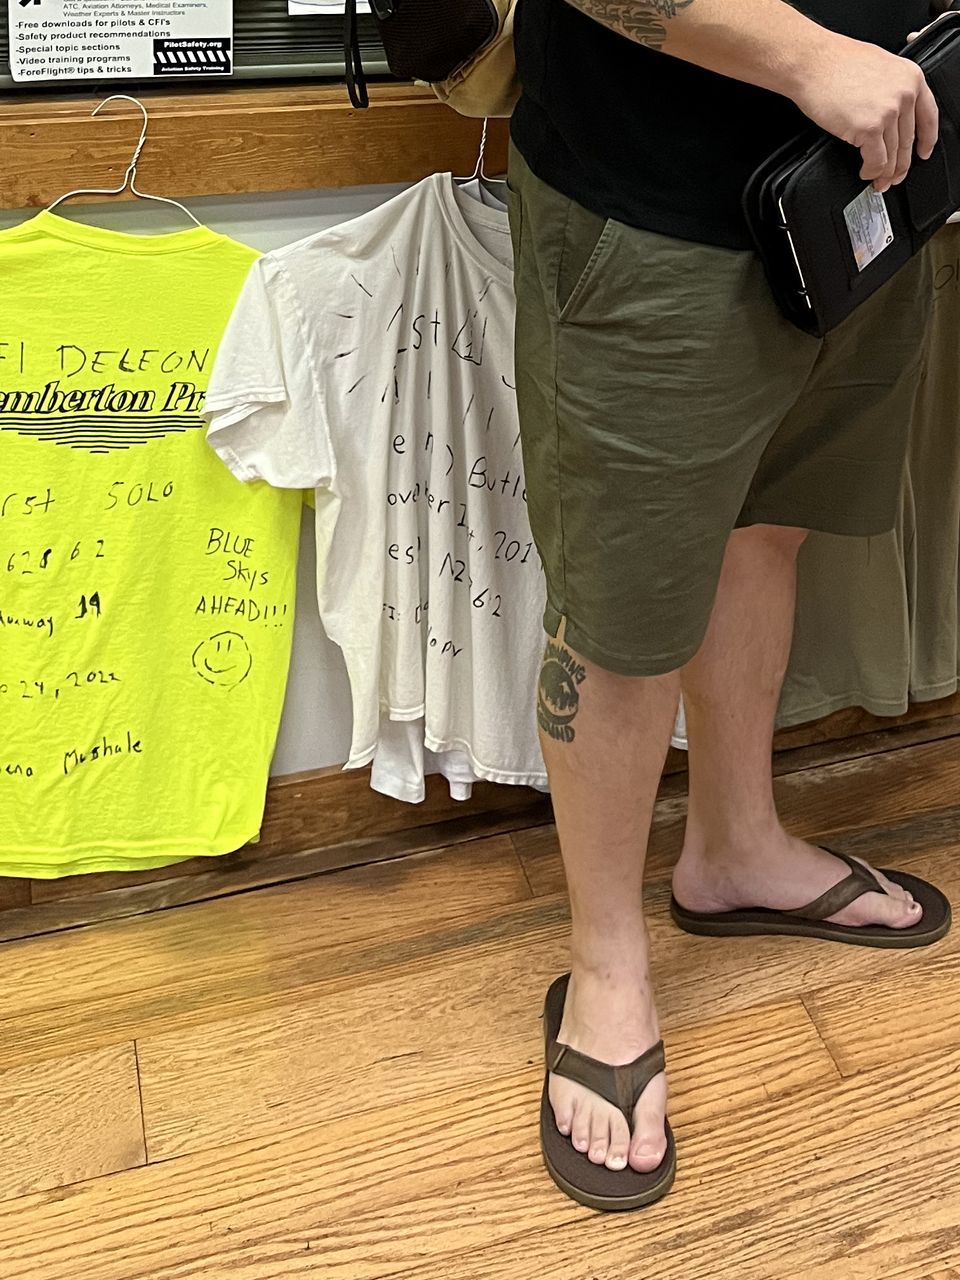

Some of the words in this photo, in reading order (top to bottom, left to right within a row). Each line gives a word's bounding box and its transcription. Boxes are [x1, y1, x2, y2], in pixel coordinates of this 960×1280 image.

[41, 20, 93, 28] downloads
[95, 19, 109, 27] for
[110, 19, 136, 27] pilots
[148, 18, 171, 26] CFI's
[50, 31, 87, 40] product
[89, 30, 171, 39] recommendations
[55, 44, 79, 53] topic
[81, 43, 121, 51] sections
[163, 40, 223, 48] PilotSafety.org
[48, 55, 84, 64] training
[86, 55, 131, 64] programs
[77, 65, 94, 75] tips
[96, 65, 104, 73] &
[106, 65, 132, 73] tricks
[56, 344, 210, 378] DELEON
[104, 481, 174, 511] SOLO
[205, 526, 255, 558] BLUE
[195, 594, 288, 628] AHEAD!!!
